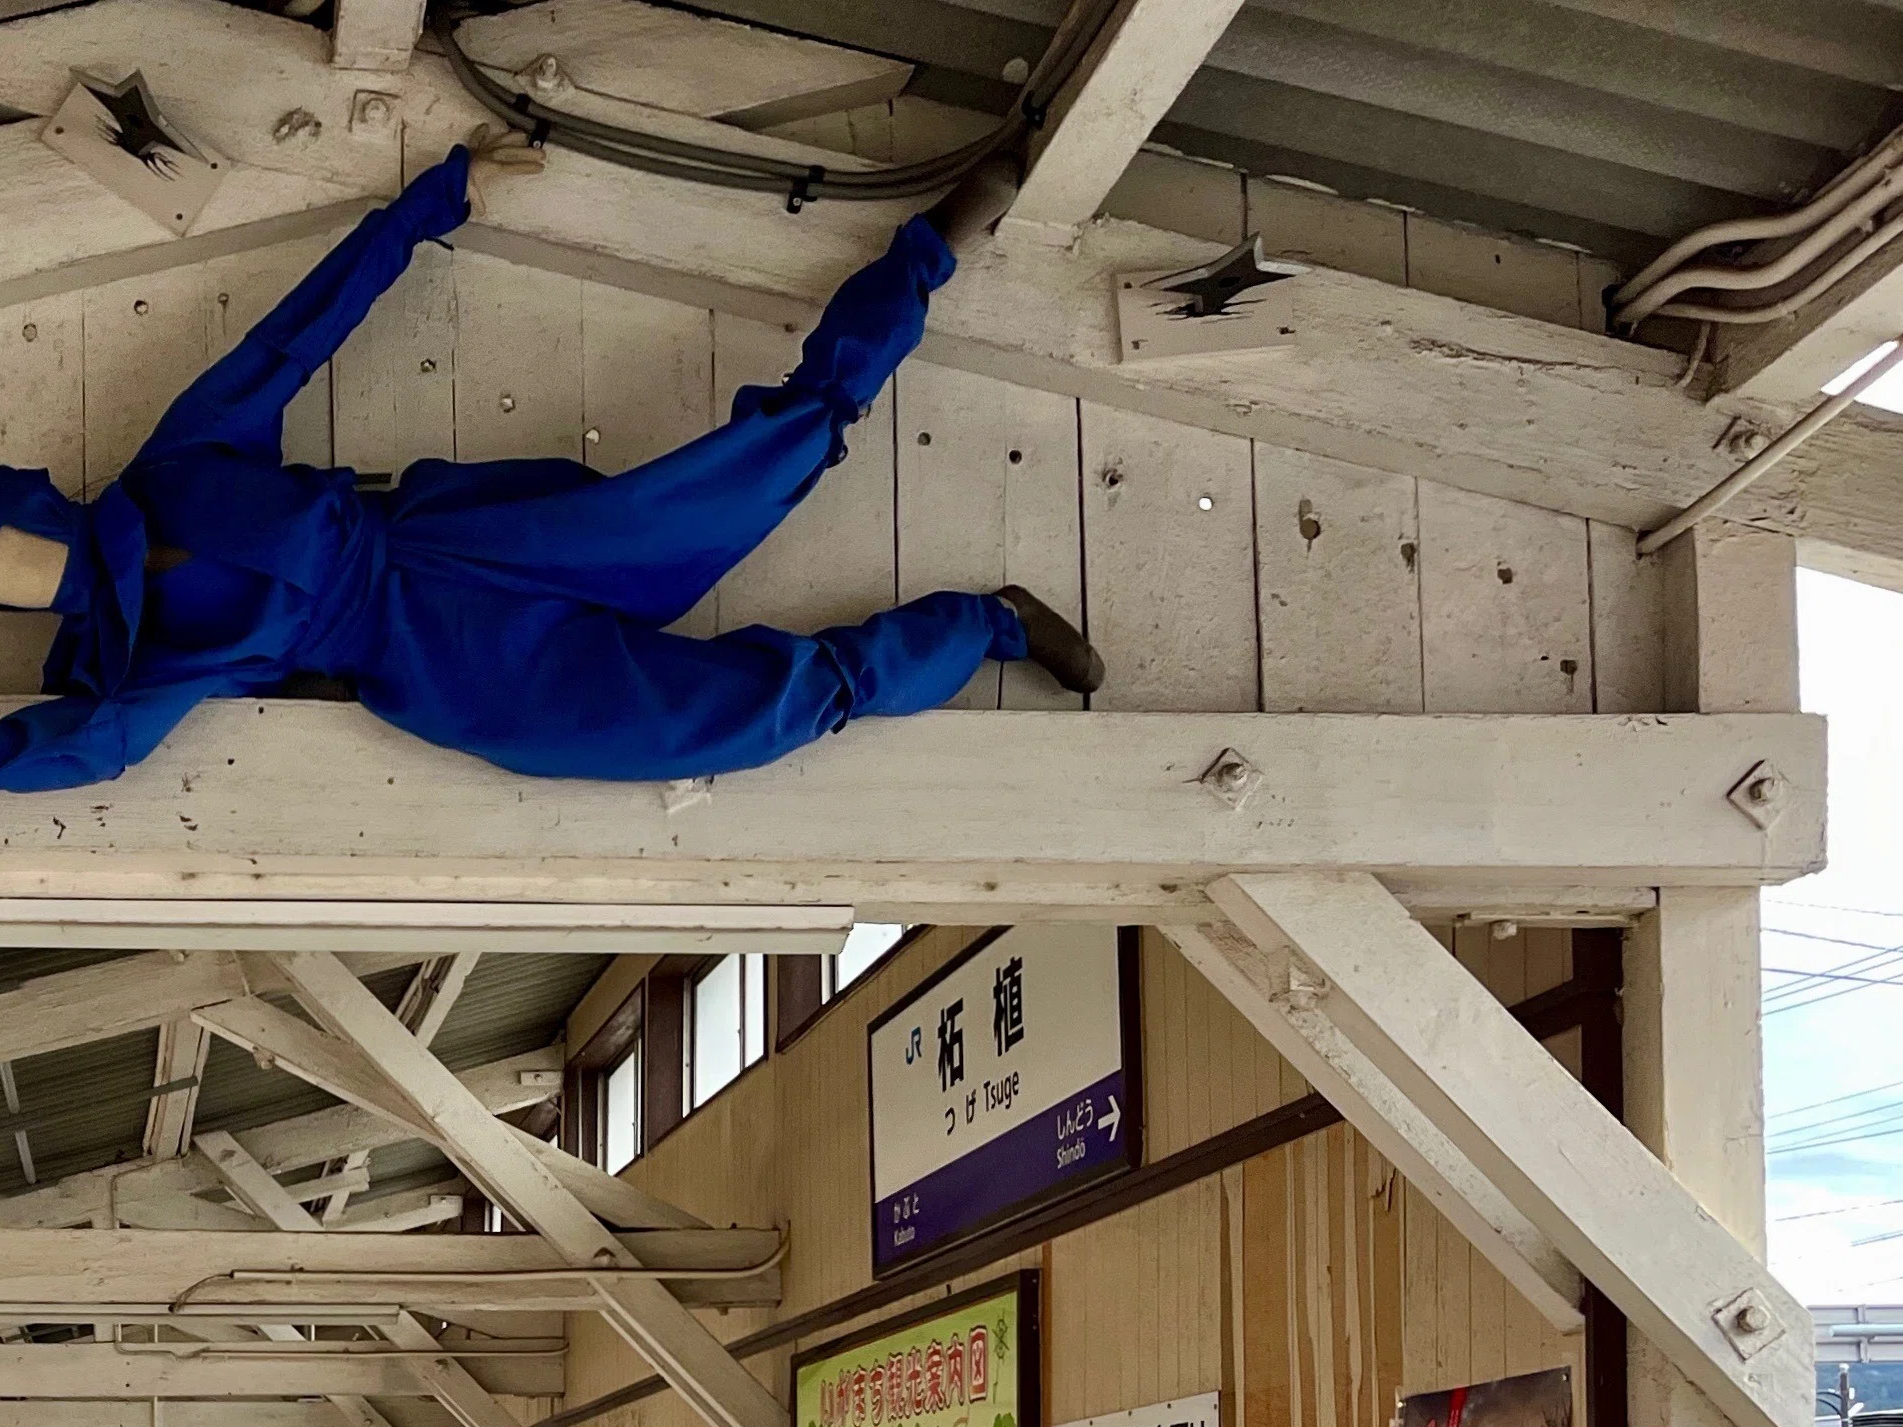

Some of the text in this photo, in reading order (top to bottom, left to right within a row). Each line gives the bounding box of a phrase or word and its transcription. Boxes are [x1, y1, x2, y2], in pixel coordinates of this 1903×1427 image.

[905, 956, 1024, 1093] JR 柘植
[983, 1070, 1020, 1112] Tsuge
[1057, 1098, 1095, 1140] しんどう
